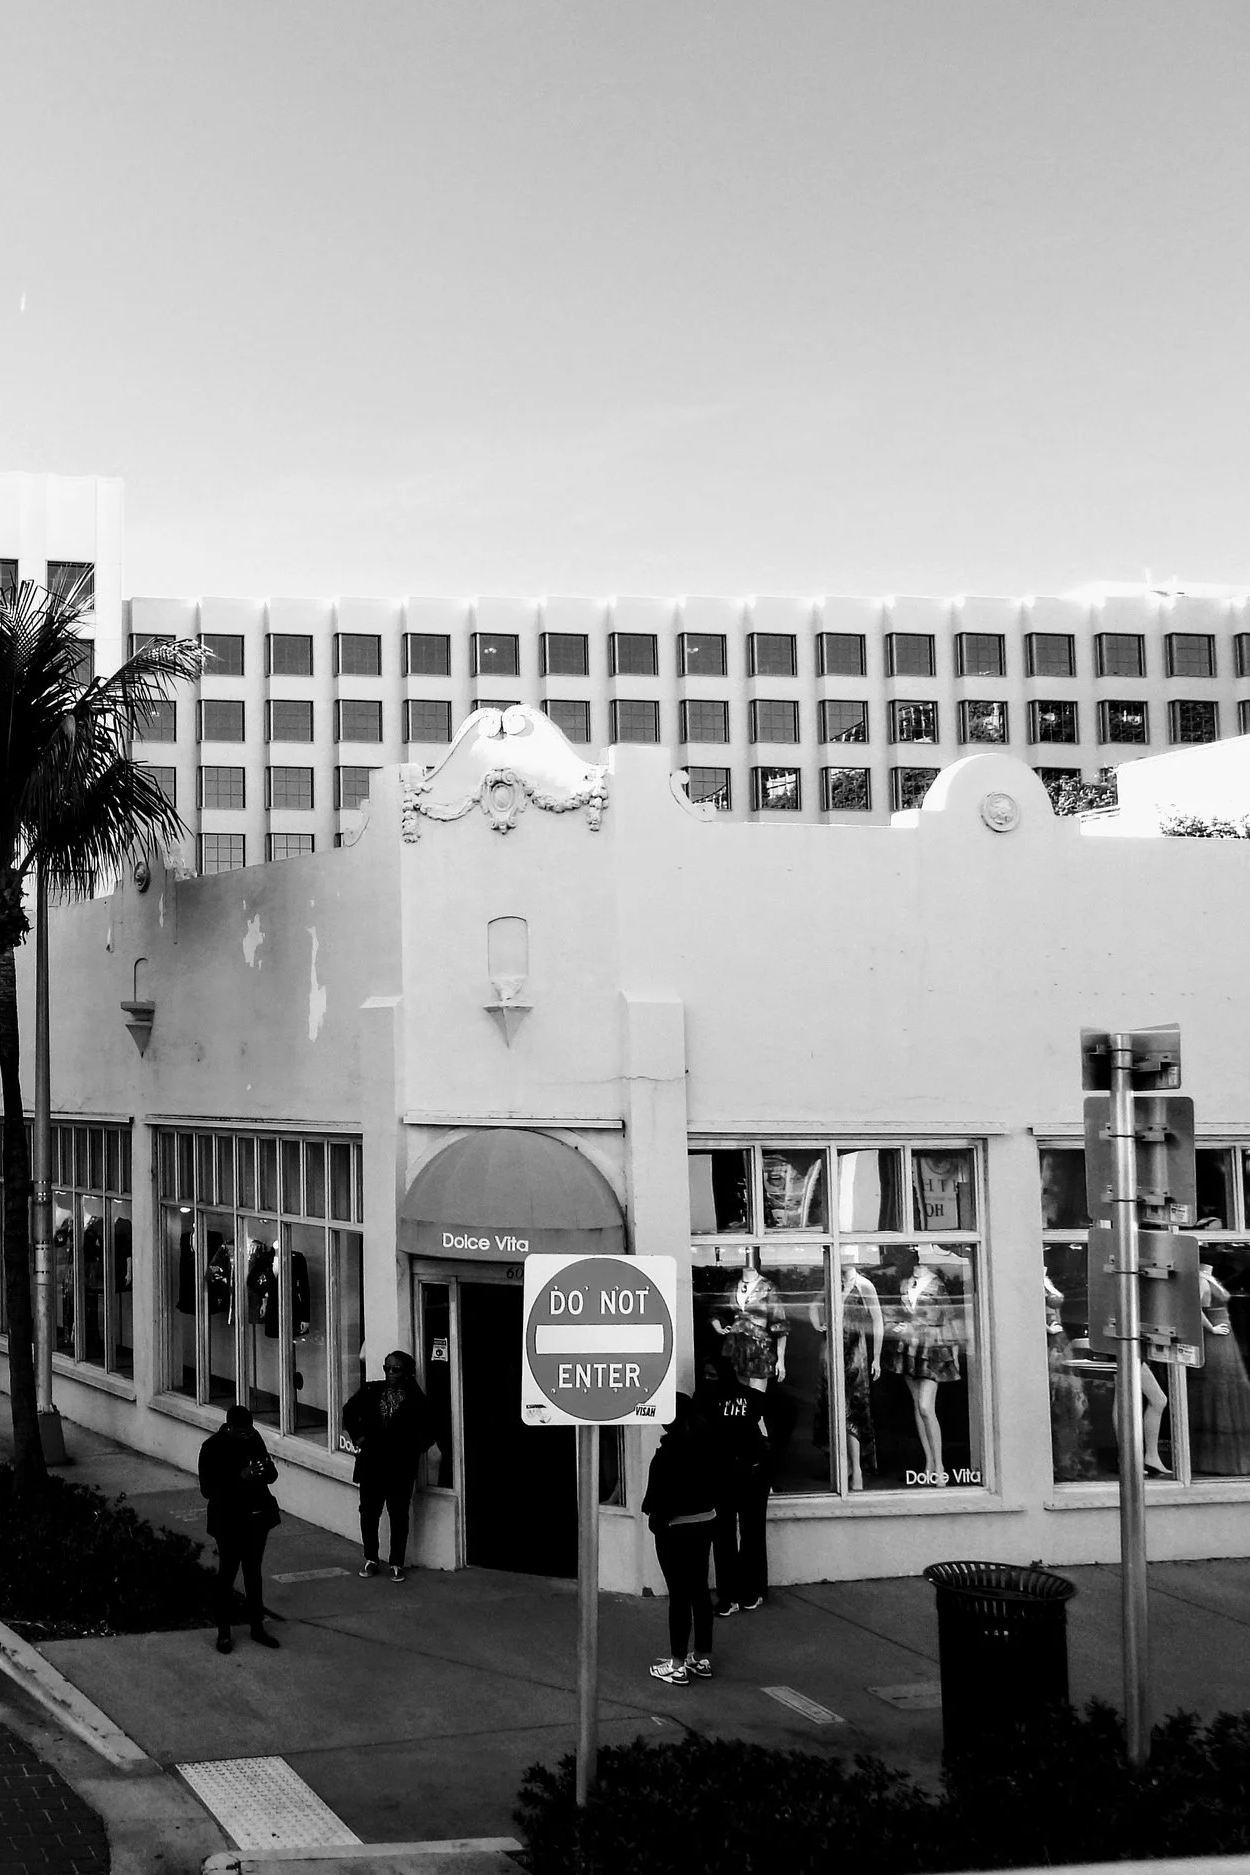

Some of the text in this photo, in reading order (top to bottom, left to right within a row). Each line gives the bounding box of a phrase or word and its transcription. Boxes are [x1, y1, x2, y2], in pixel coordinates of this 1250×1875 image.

[442, 1232, 529, 1252] Dolce Vita
[550, 1289, 649, 1315] DO NOT
[558, 1363, 641, 1388] ENTER
[905, 1468, 981, 1485] Dolce Vita
